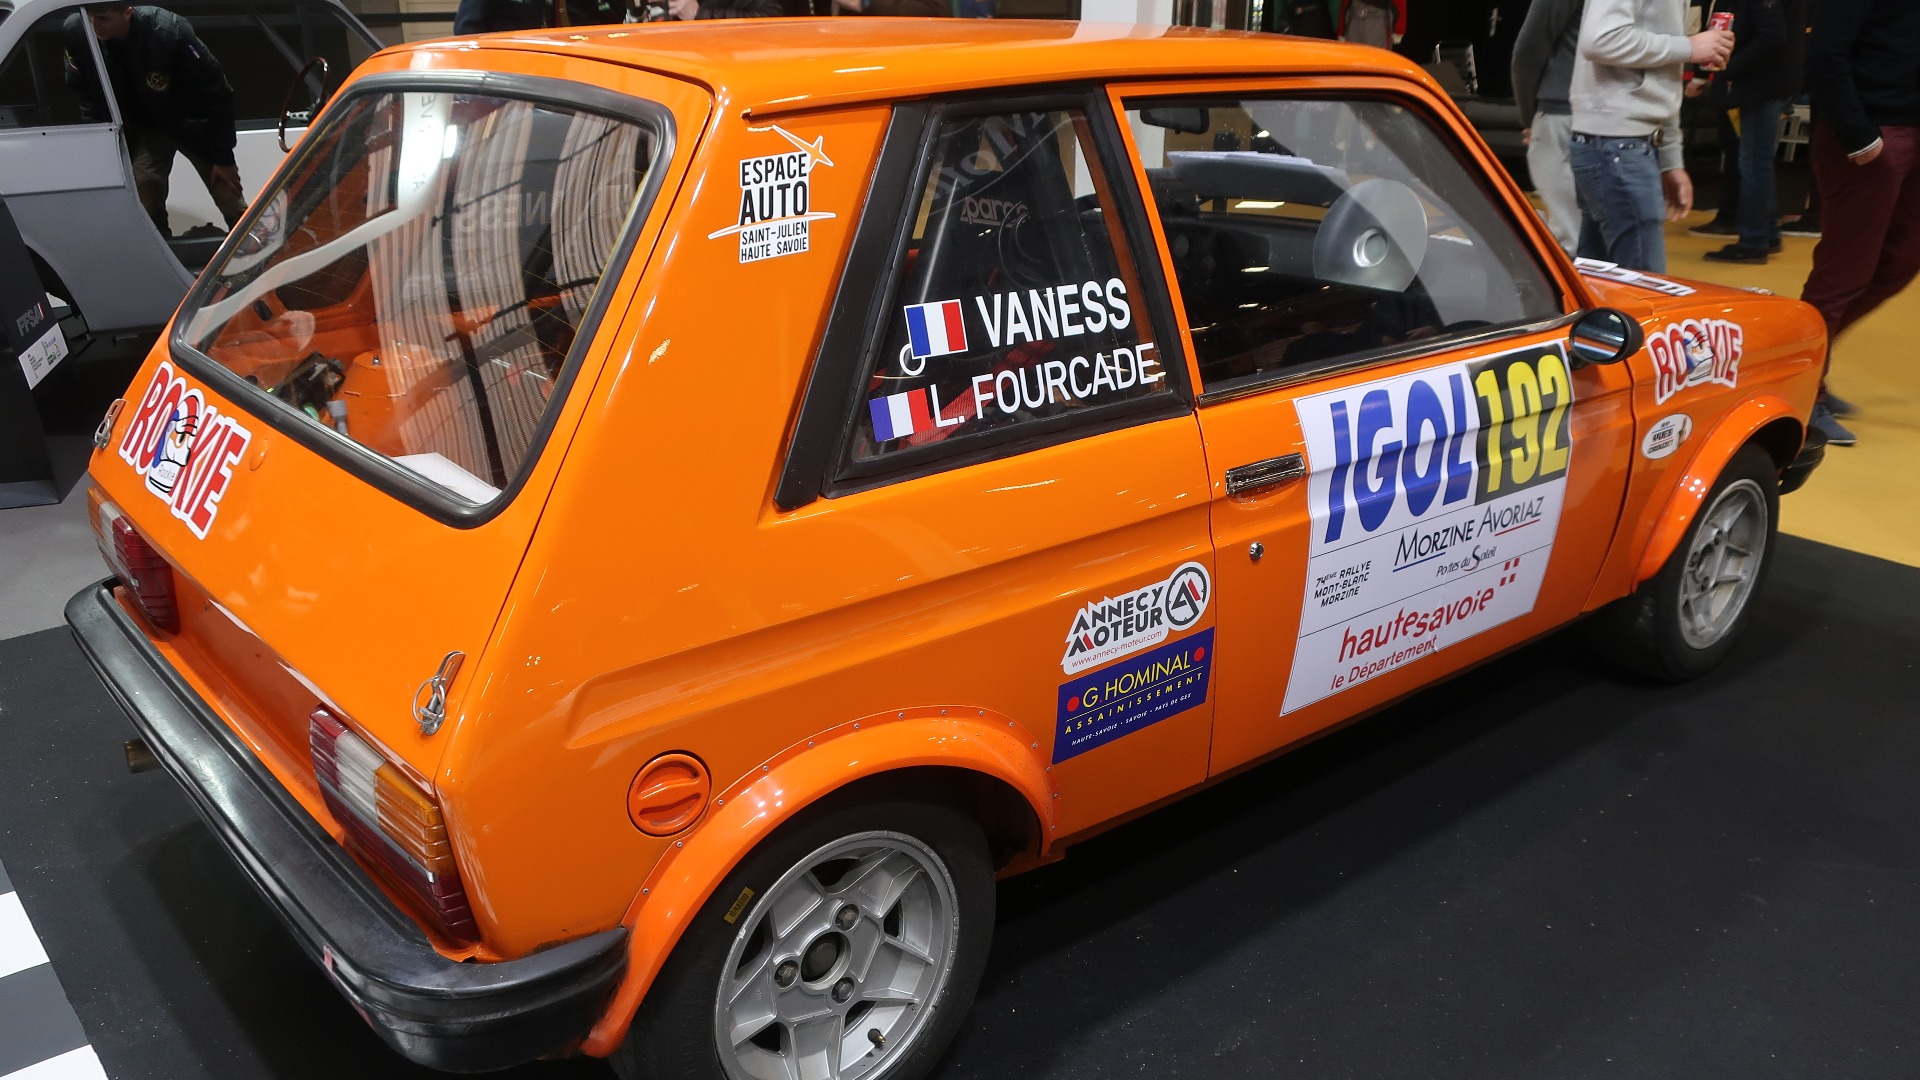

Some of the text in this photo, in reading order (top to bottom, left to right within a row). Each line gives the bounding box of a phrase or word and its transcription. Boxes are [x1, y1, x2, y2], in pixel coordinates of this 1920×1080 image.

[742, 153, 807, 186] ESPACE
[740, 181, 807, 226] AUTO
[961, 196, 1031, 225] parc
[741, 237, 807, 262] HAUTE SAVOIE
[742, 221, 807, 245] SAINT-JULIEN
[976, 278, 1131, 348] VANESS
[931, 342, 1159, 428] L. FOURCADE
[1648, 319, 1743, 403] ROKIE
[121, 365, 248, 534] ROKIE
[1324, 354, 1571, 545] IGOL 192
[1394, 496, 1545, 567] MORZINE AVORIAZ
[1339, 560, 1372, 579] RALLYE
[1073, 586, 1164, 634] ANNECY
[1321, 586, 1360, 607] MORZINE
[1068, 607, 1162, 657] MOTEUR
[1071, 631, 1162, 668] www.annecy-moteur.com
[1338, 587, 1495, 663] hautesavoie
[1331, 635, 1437, 690] le Département
[1065, 672, 1203, 735] ASSAINISSEMENT
[1071, 723, 1118, 746] HAUTE-SAVOIE
[1125, 711, 1147, 724] SAVOIE
